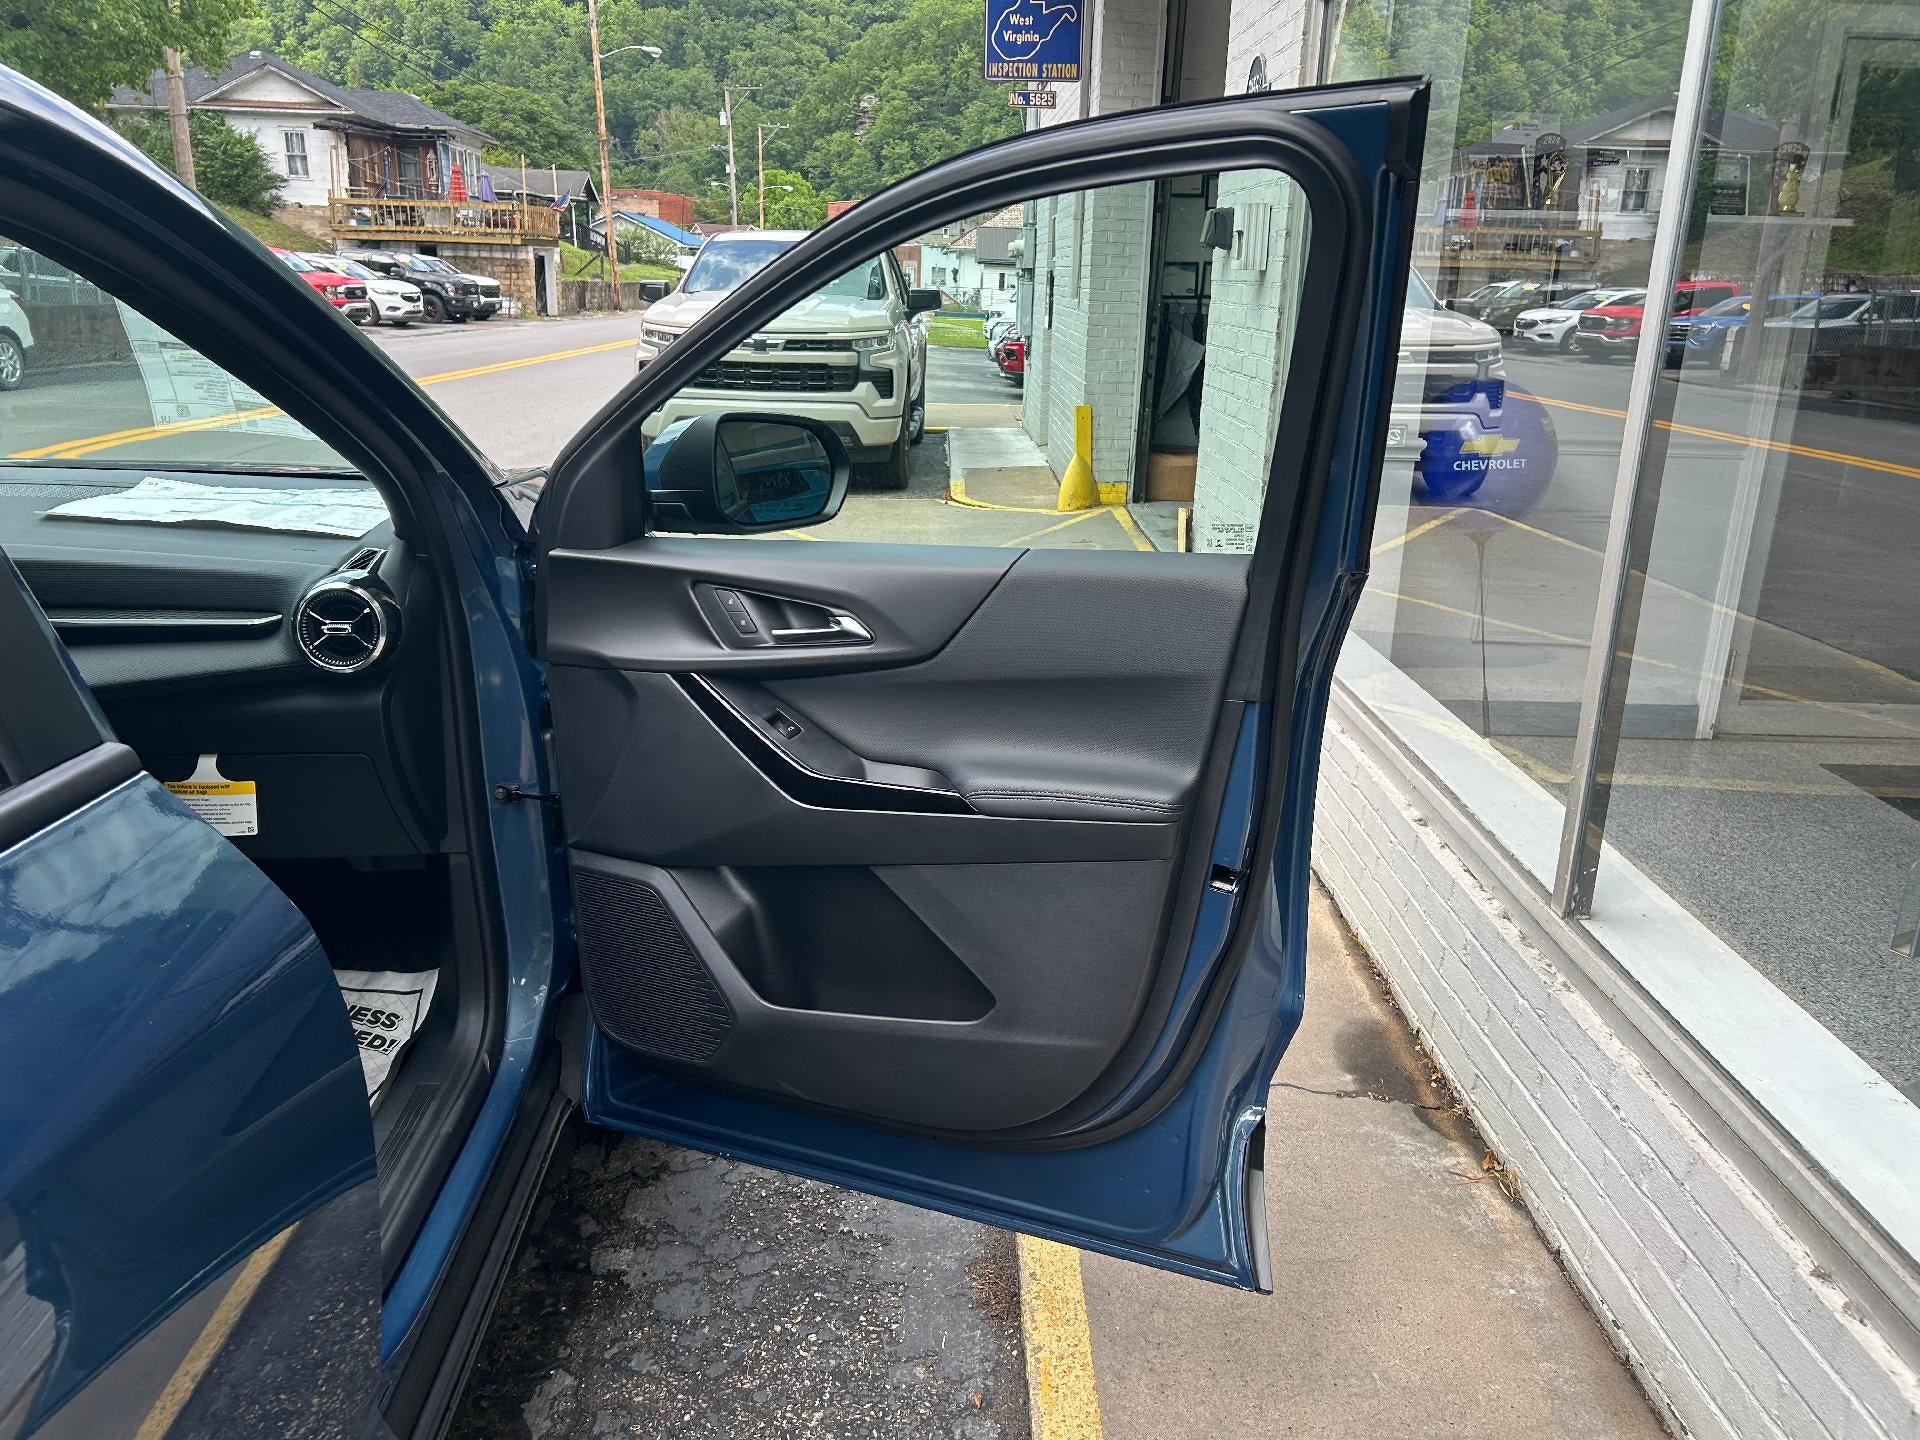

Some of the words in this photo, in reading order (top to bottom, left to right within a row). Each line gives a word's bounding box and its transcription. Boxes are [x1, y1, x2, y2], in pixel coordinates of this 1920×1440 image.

[1009, 14, 1033, 25] West
[1003, 31, 1040, 44] Virginia
[989, 63, 1038, 77] INSPECTION
[1042, 64, 1077, 78] STATION
[1009, 93, 1026, 105] No.
[1029, 93, 1054, 105] 5625
[1453, 458, 1527, 471] CHEVROLET
